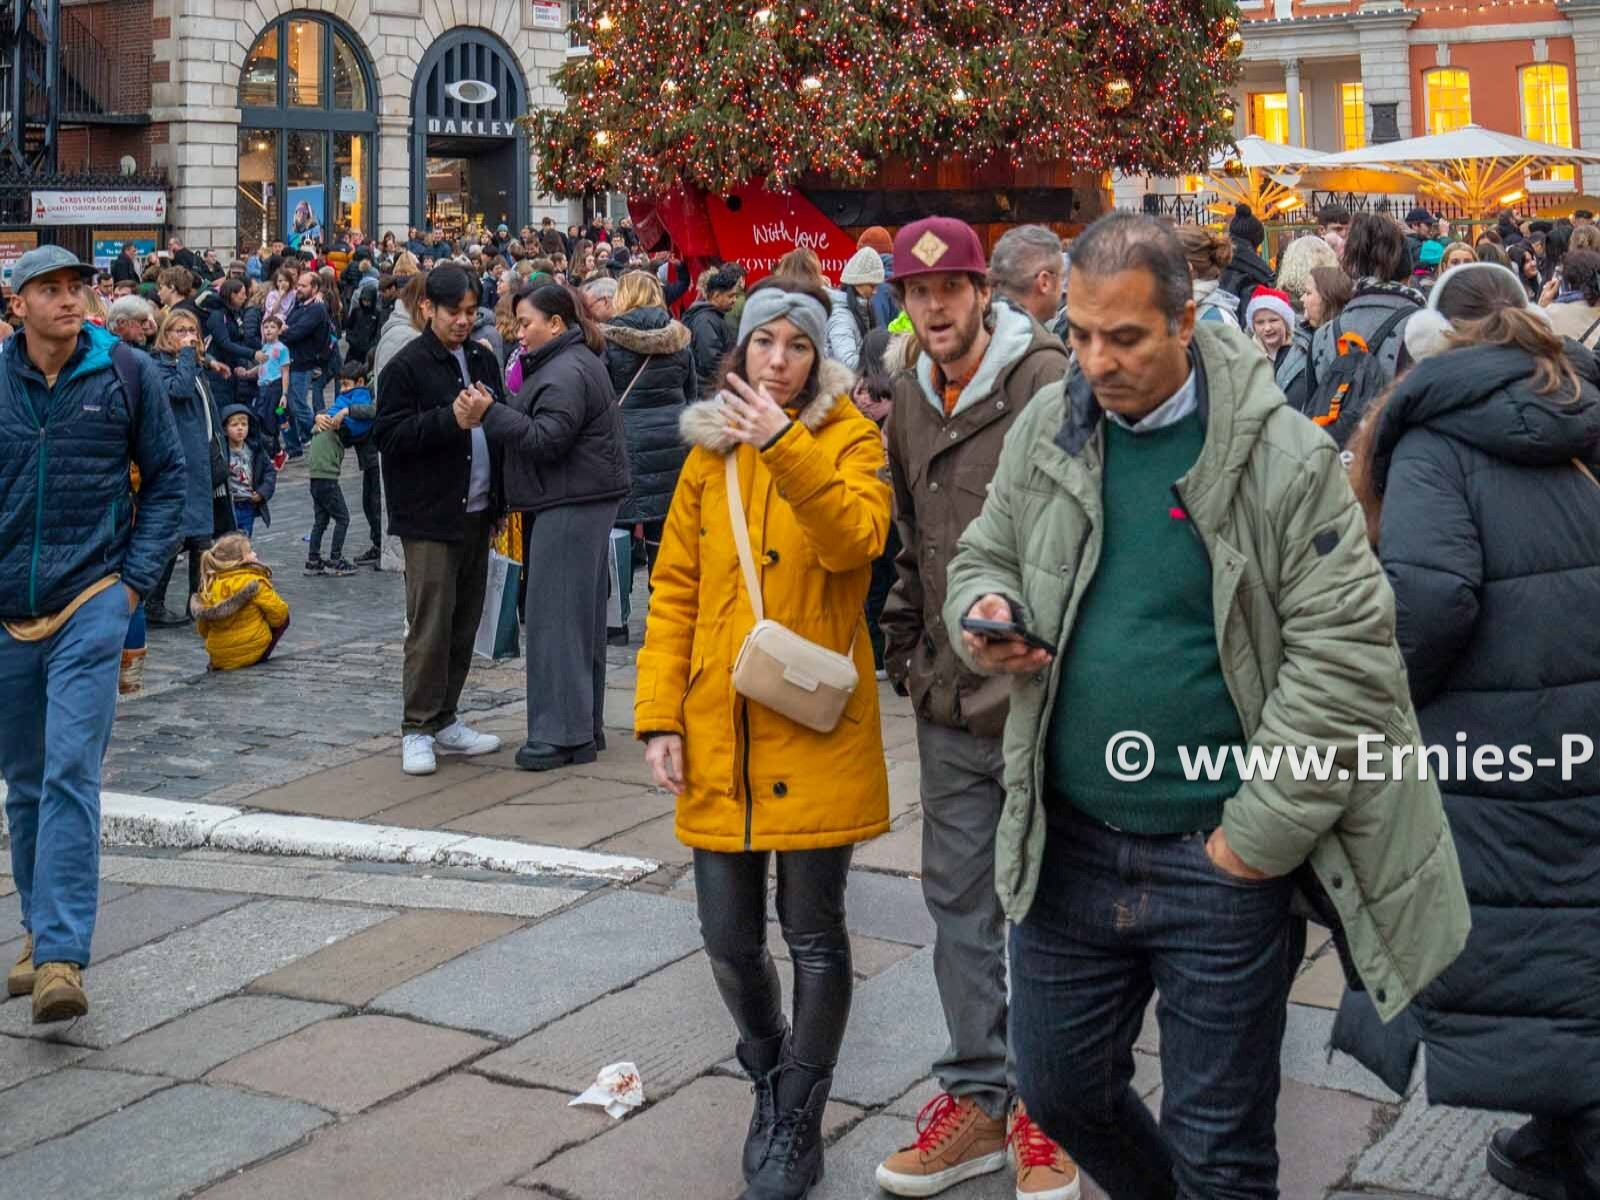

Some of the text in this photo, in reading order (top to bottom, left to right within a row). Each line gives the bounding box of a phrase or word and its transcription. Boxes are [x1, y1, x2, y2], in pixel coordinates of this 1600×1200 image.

[428, 119, 515, 136] OAKLEY
[60, 196, 81, 204] CARDS
[83, 196, 95, 204] FOR
[753, 220, 830, 249] With love
